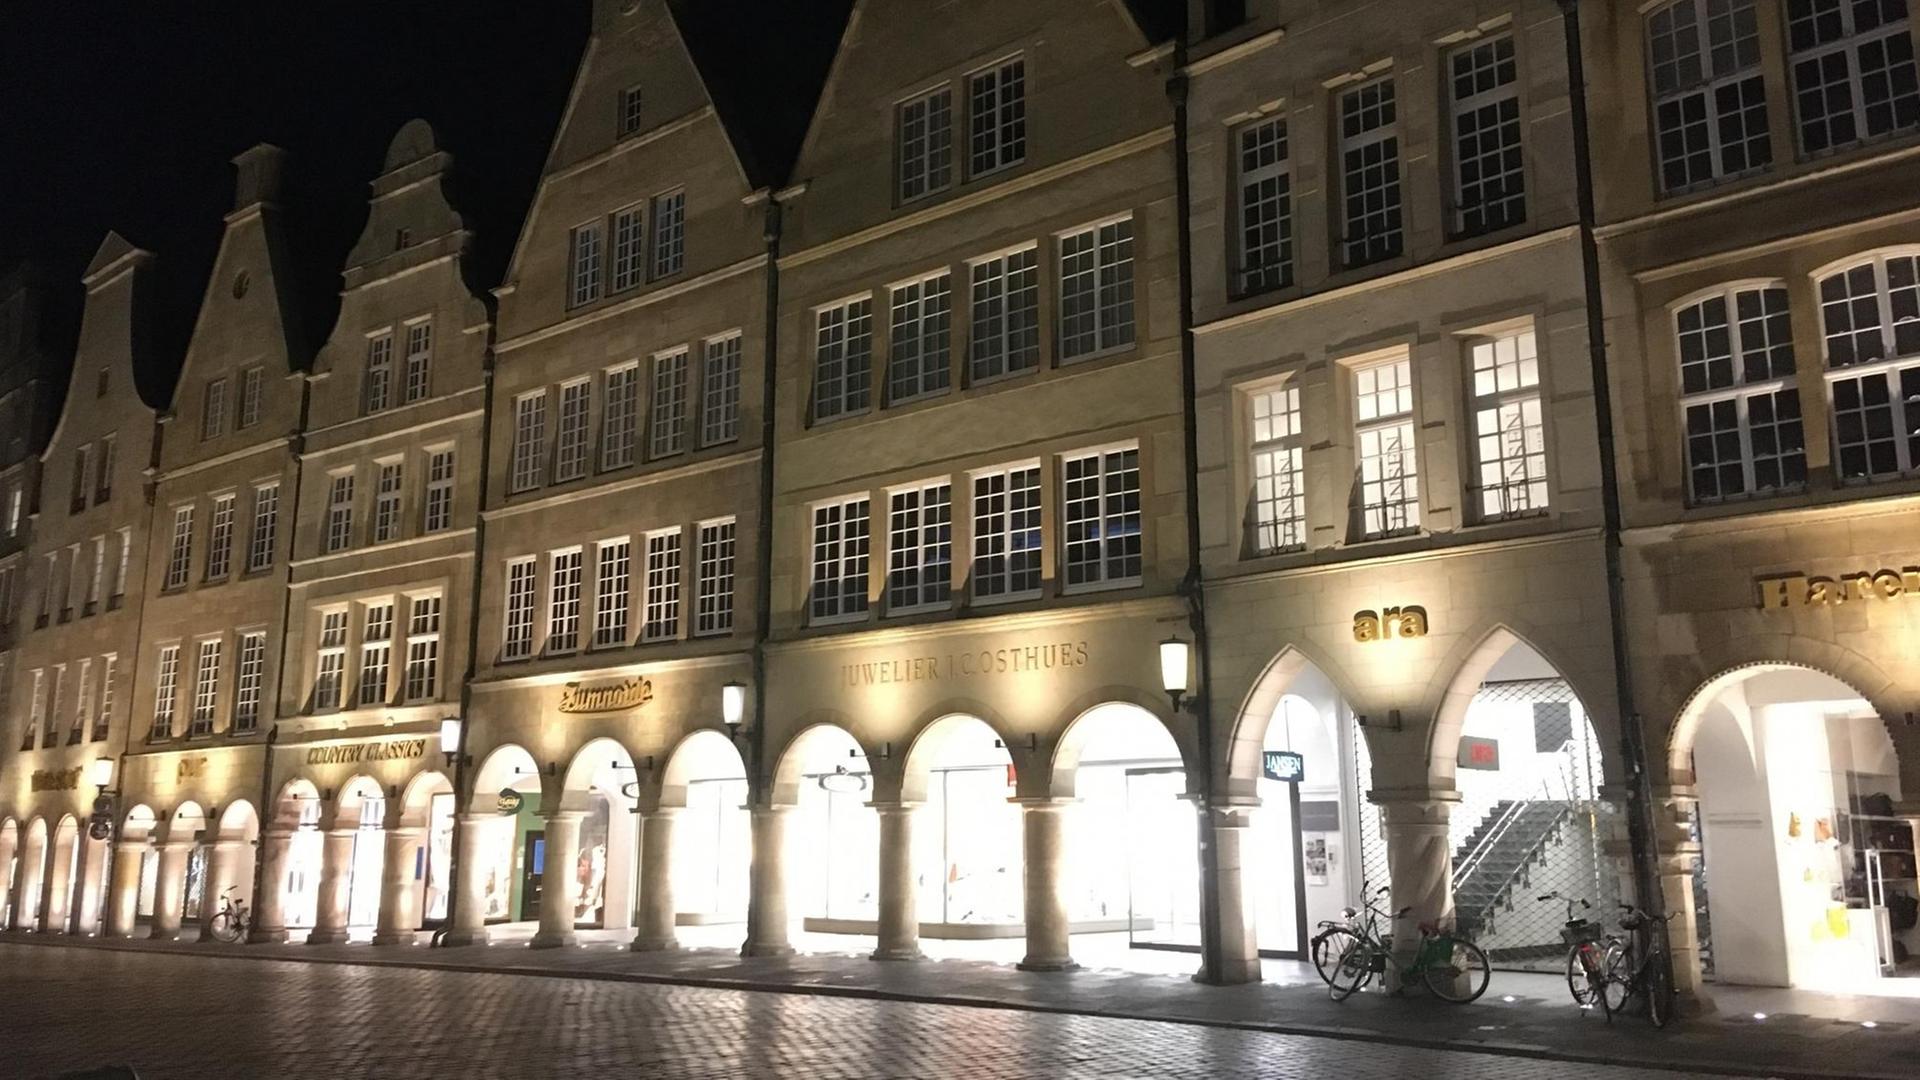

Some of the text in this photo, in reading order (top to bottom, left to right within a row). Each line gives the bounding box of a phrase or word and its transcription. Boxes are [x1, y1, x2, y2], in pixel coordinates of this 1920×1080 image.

[1353, 606, 1428, 642] ara
[841, 657, 939, 691] JUWELIER
[306, 739, 426, 765] COUNTRY CLASSICS
